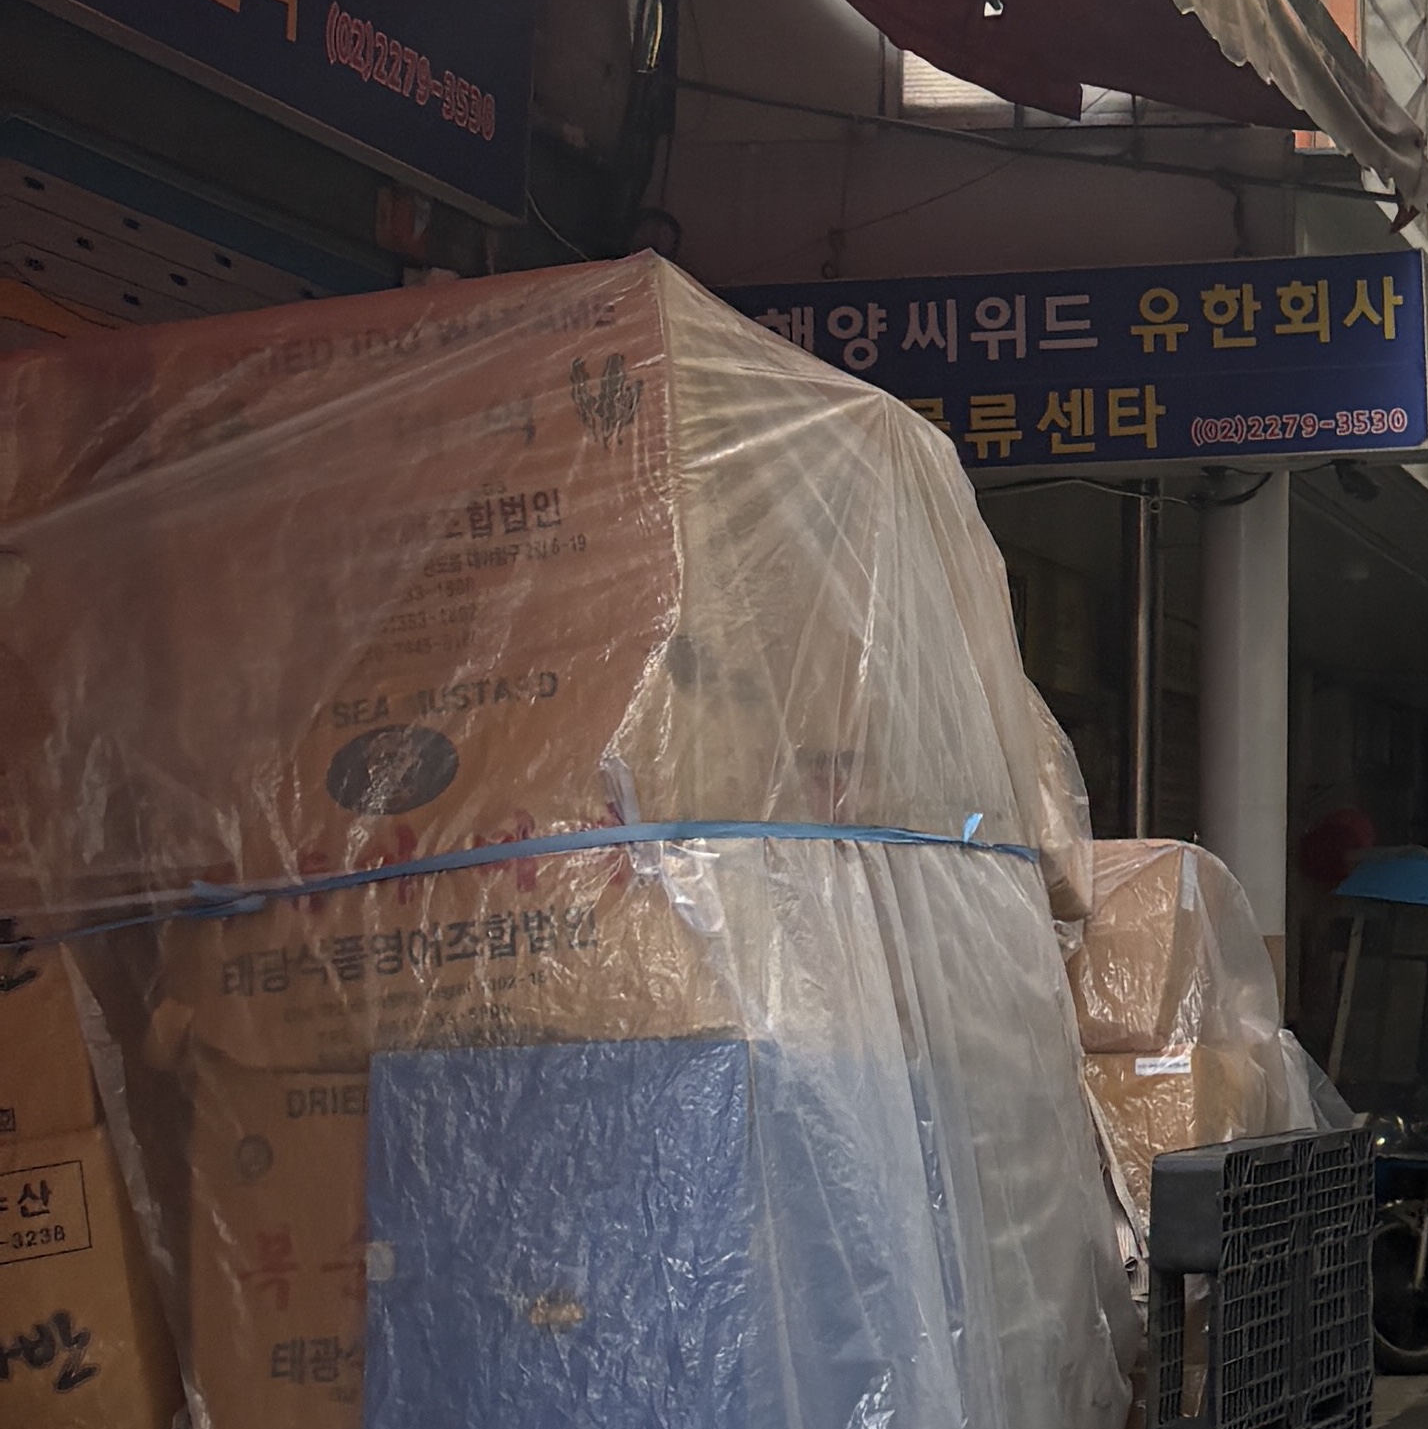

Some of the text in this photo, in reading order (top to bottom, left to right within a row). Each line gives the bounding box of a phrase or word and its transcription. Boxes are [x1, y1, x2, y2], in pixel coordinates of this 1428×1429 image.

[325, 1, 497, 142] (02)2279-3530
[1130, 275, 1404, 353] 유한회사
[1190, 407, 1408, 447] (02)2279-3530
[331, 695, 391, 729] SEA
